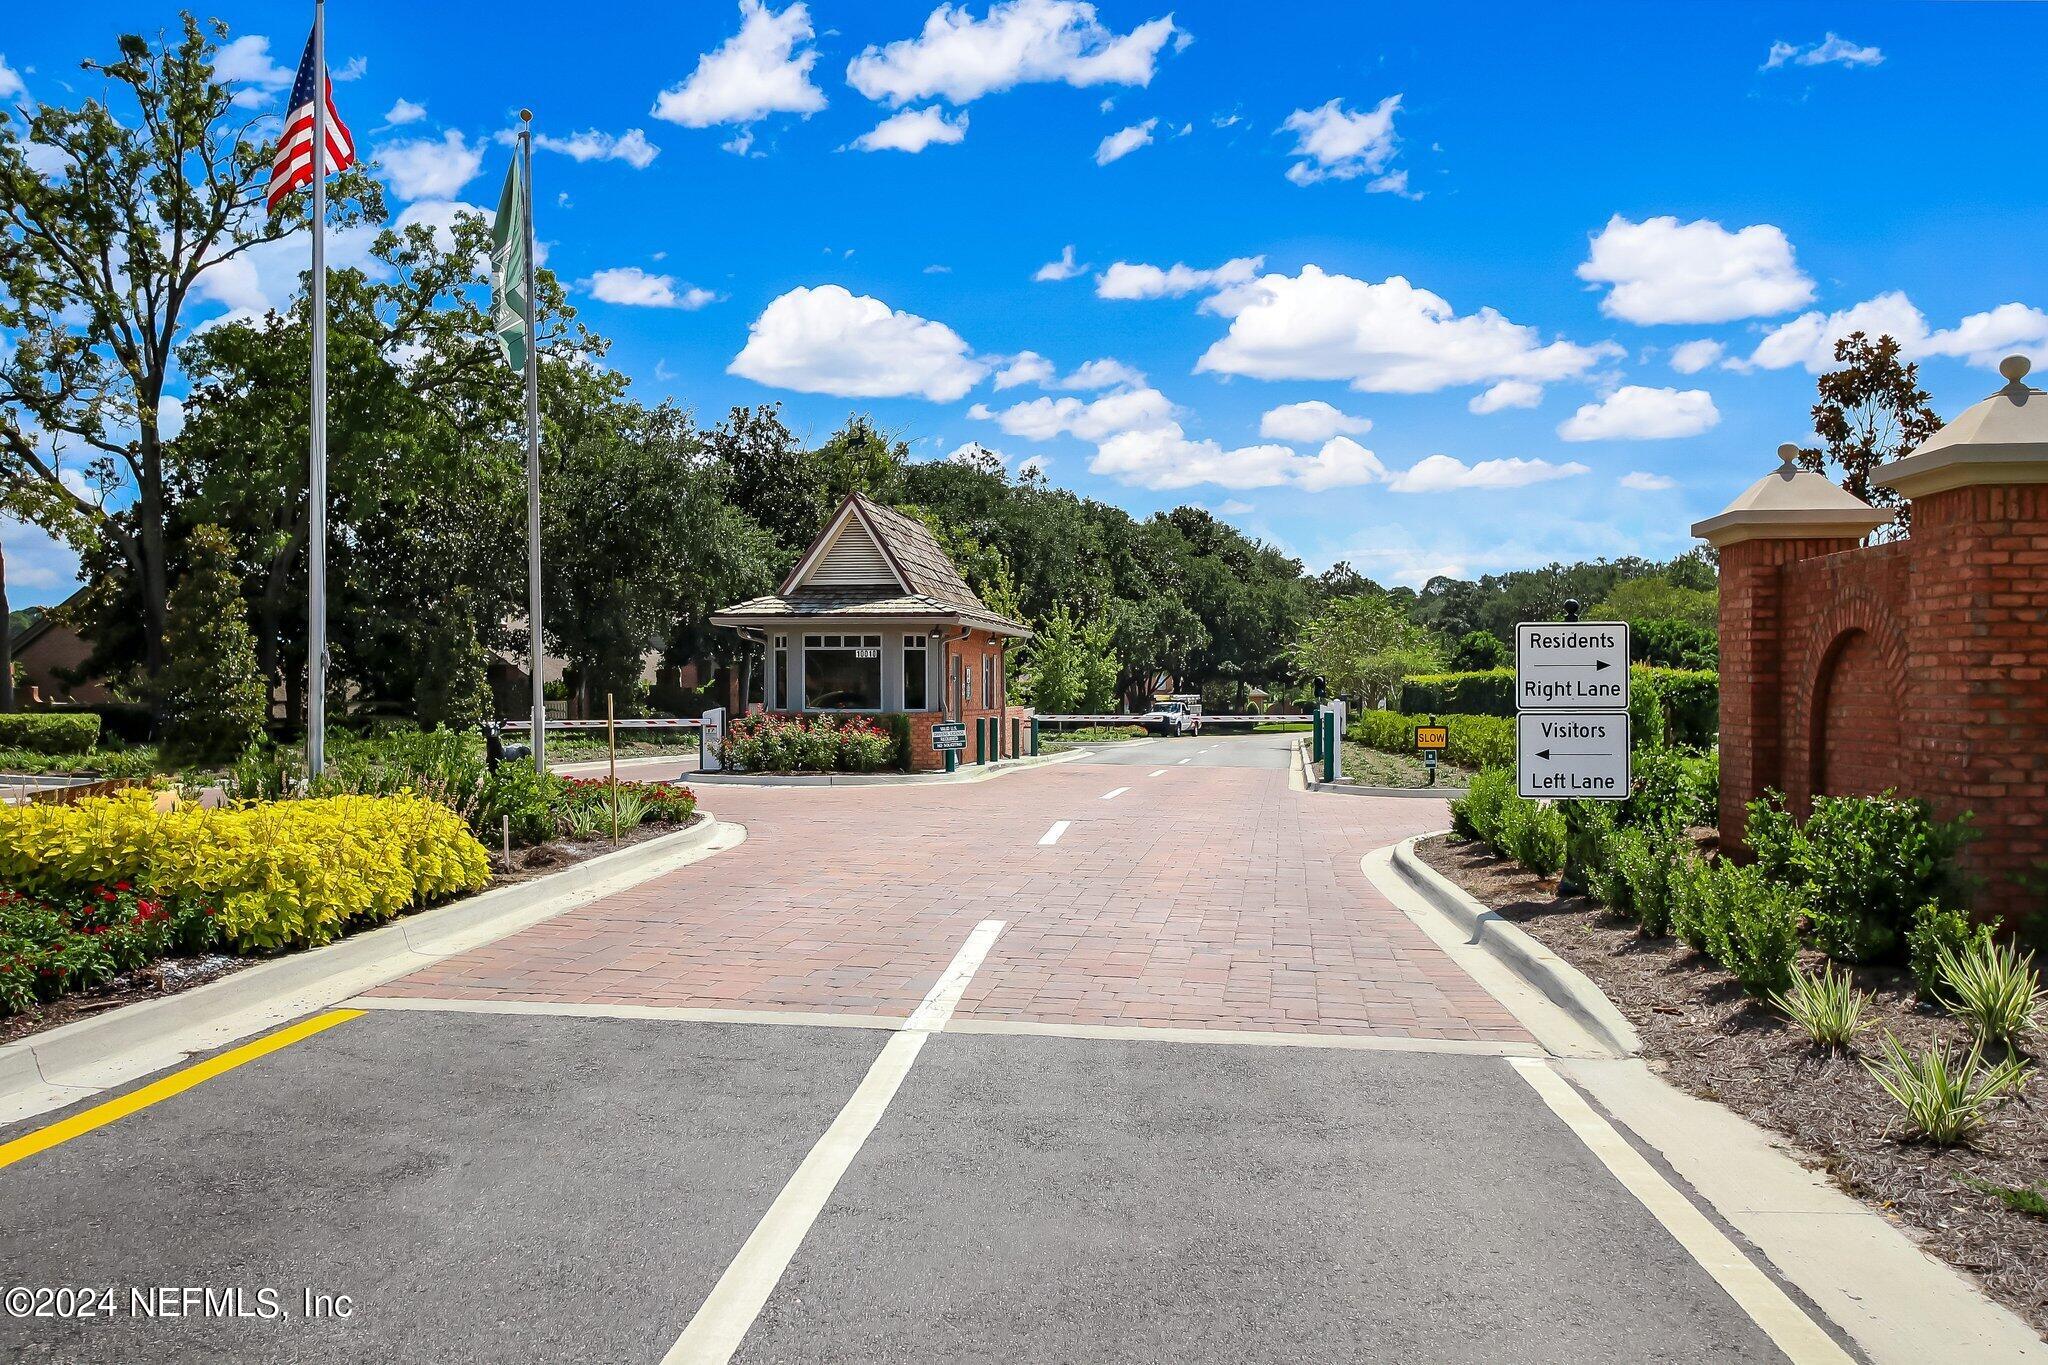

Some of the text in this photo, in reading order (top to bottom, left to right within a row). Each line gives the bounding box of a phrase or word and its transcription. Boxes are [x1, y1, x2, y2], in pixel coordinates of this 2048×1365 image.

[1530, 632, 1615, 649] Residents
[1525, 680, 1621, 701] Right Lane
[1418, 733, 1445, 743] SLOW
[1541, 722, 1606, 738] Visitors
[1532, 773, 1615, 789] Left Lane
